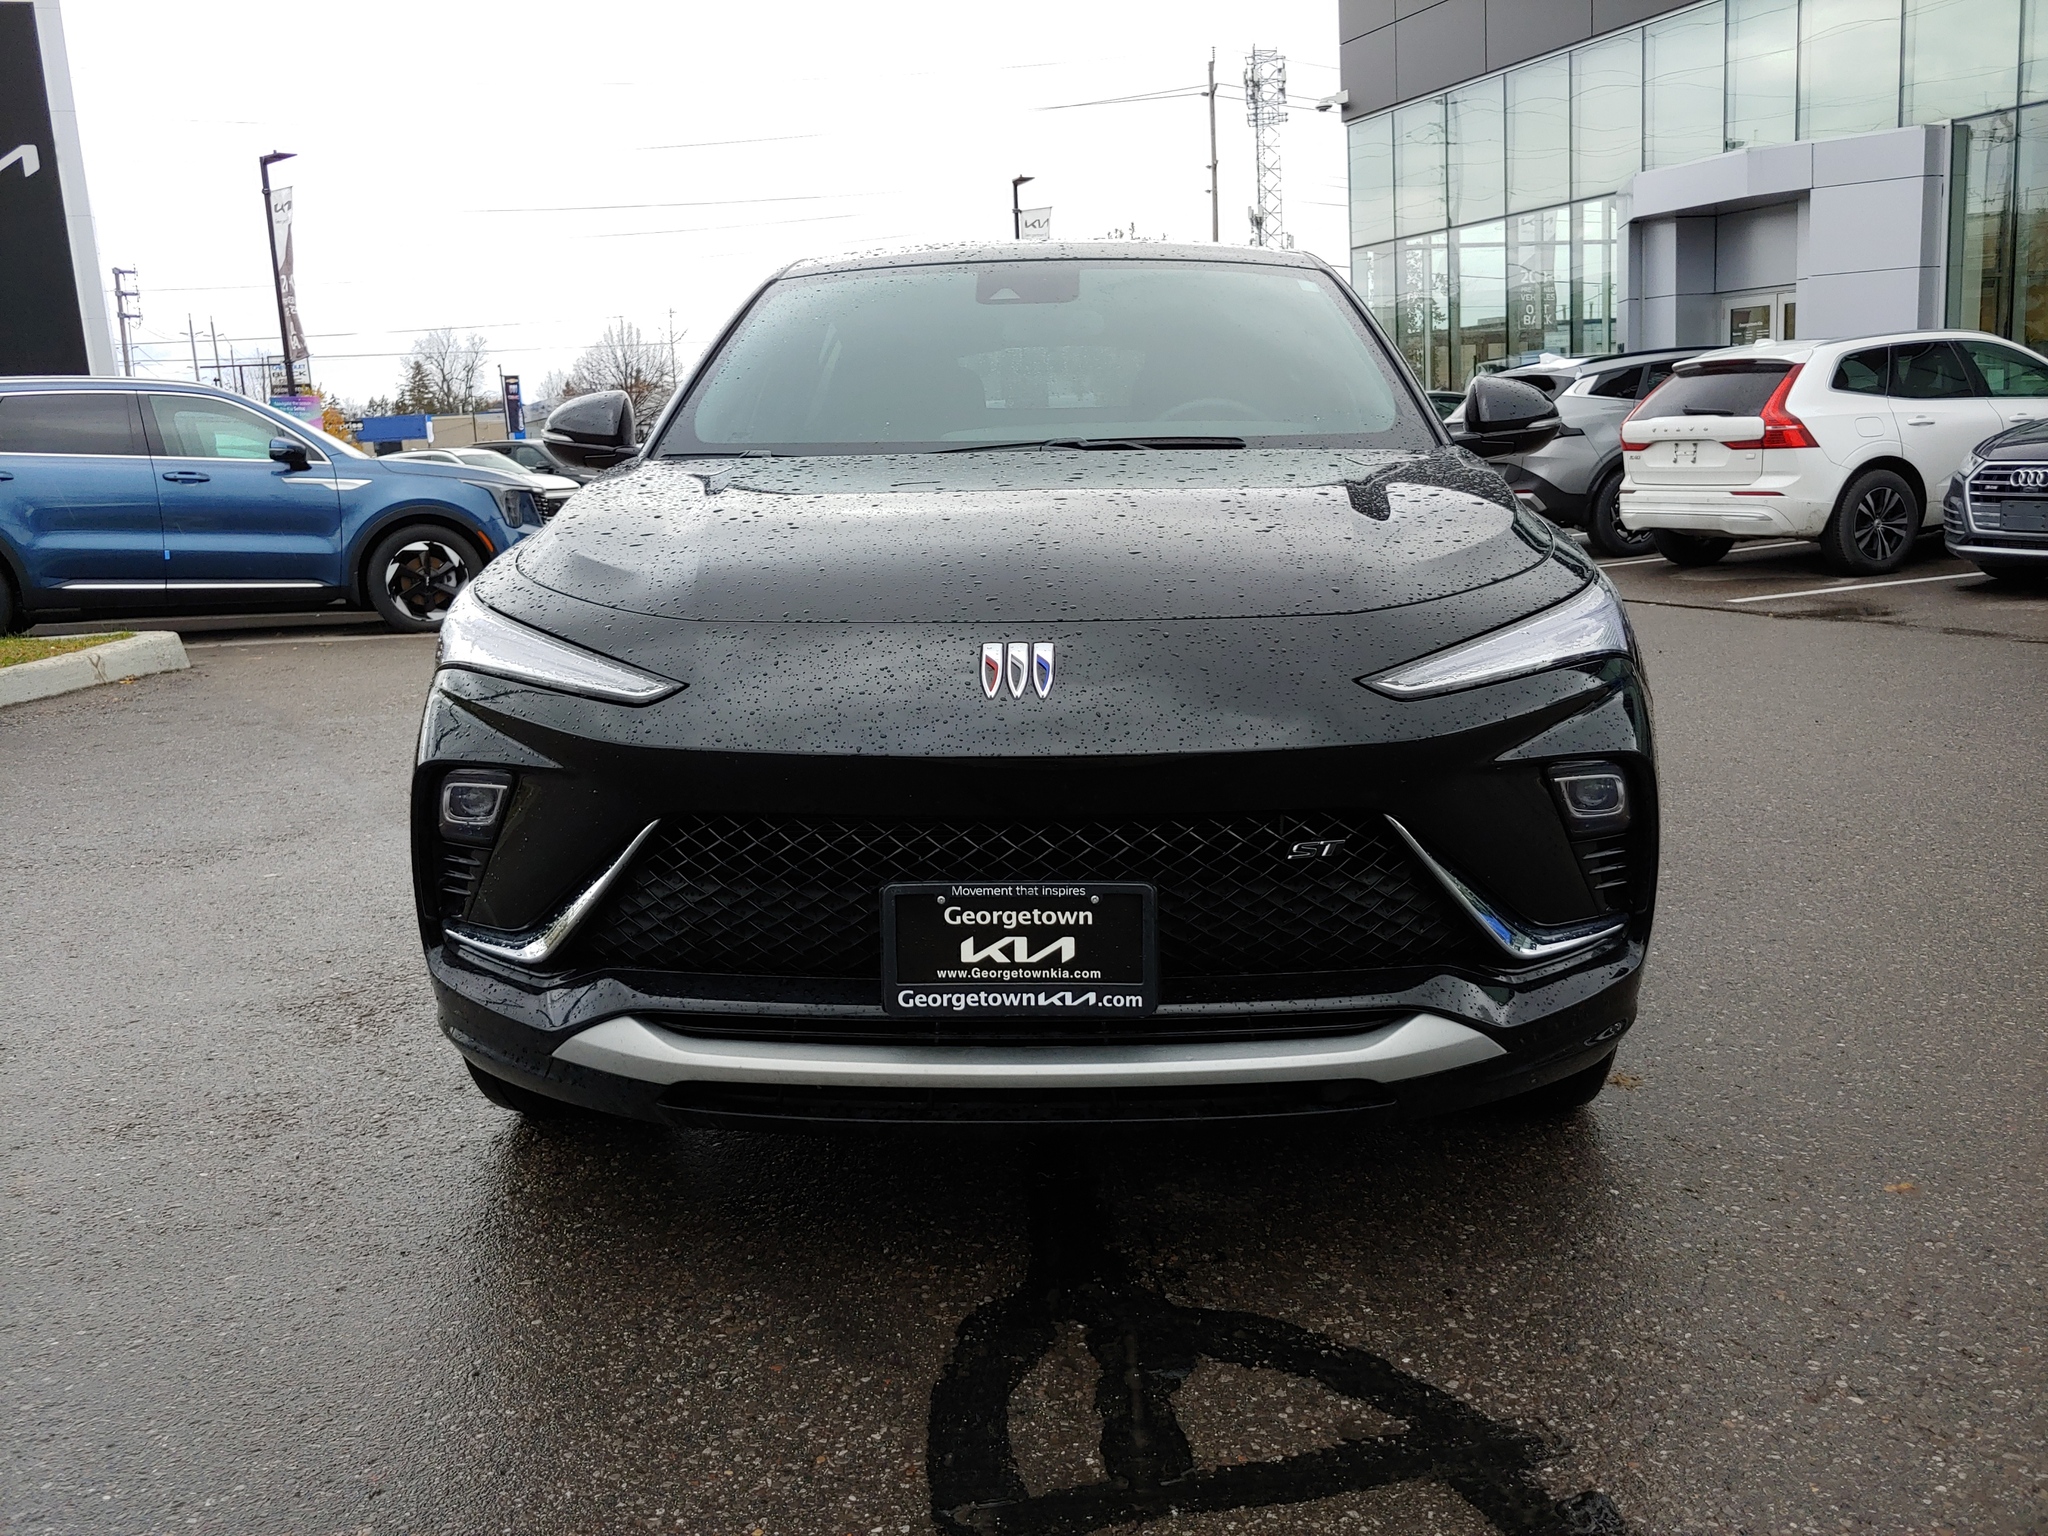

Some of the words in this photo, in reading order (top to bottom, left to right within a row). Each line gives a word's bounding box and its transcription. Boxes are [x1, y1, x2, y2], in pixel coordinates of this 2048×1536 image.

[1025, 218, 1050, 229] KIA
[1520, 293, 1555, 301] VEHES
[1525, 304, 1550, 315] OT
[1523, 314, 1552, 325] BAK
[1286, 839, 1346, 860] ST
[951, 885, 1013, 896] Movement
[1015, 885, 1039, 896] that
[1041, 885, 1086, 898] inspires
[943, 906, 1093, 929] Georgetown
[960, 936, 1076, 963] KIA
[936, 967, 1102, 980] www.Georgetownkia.com
